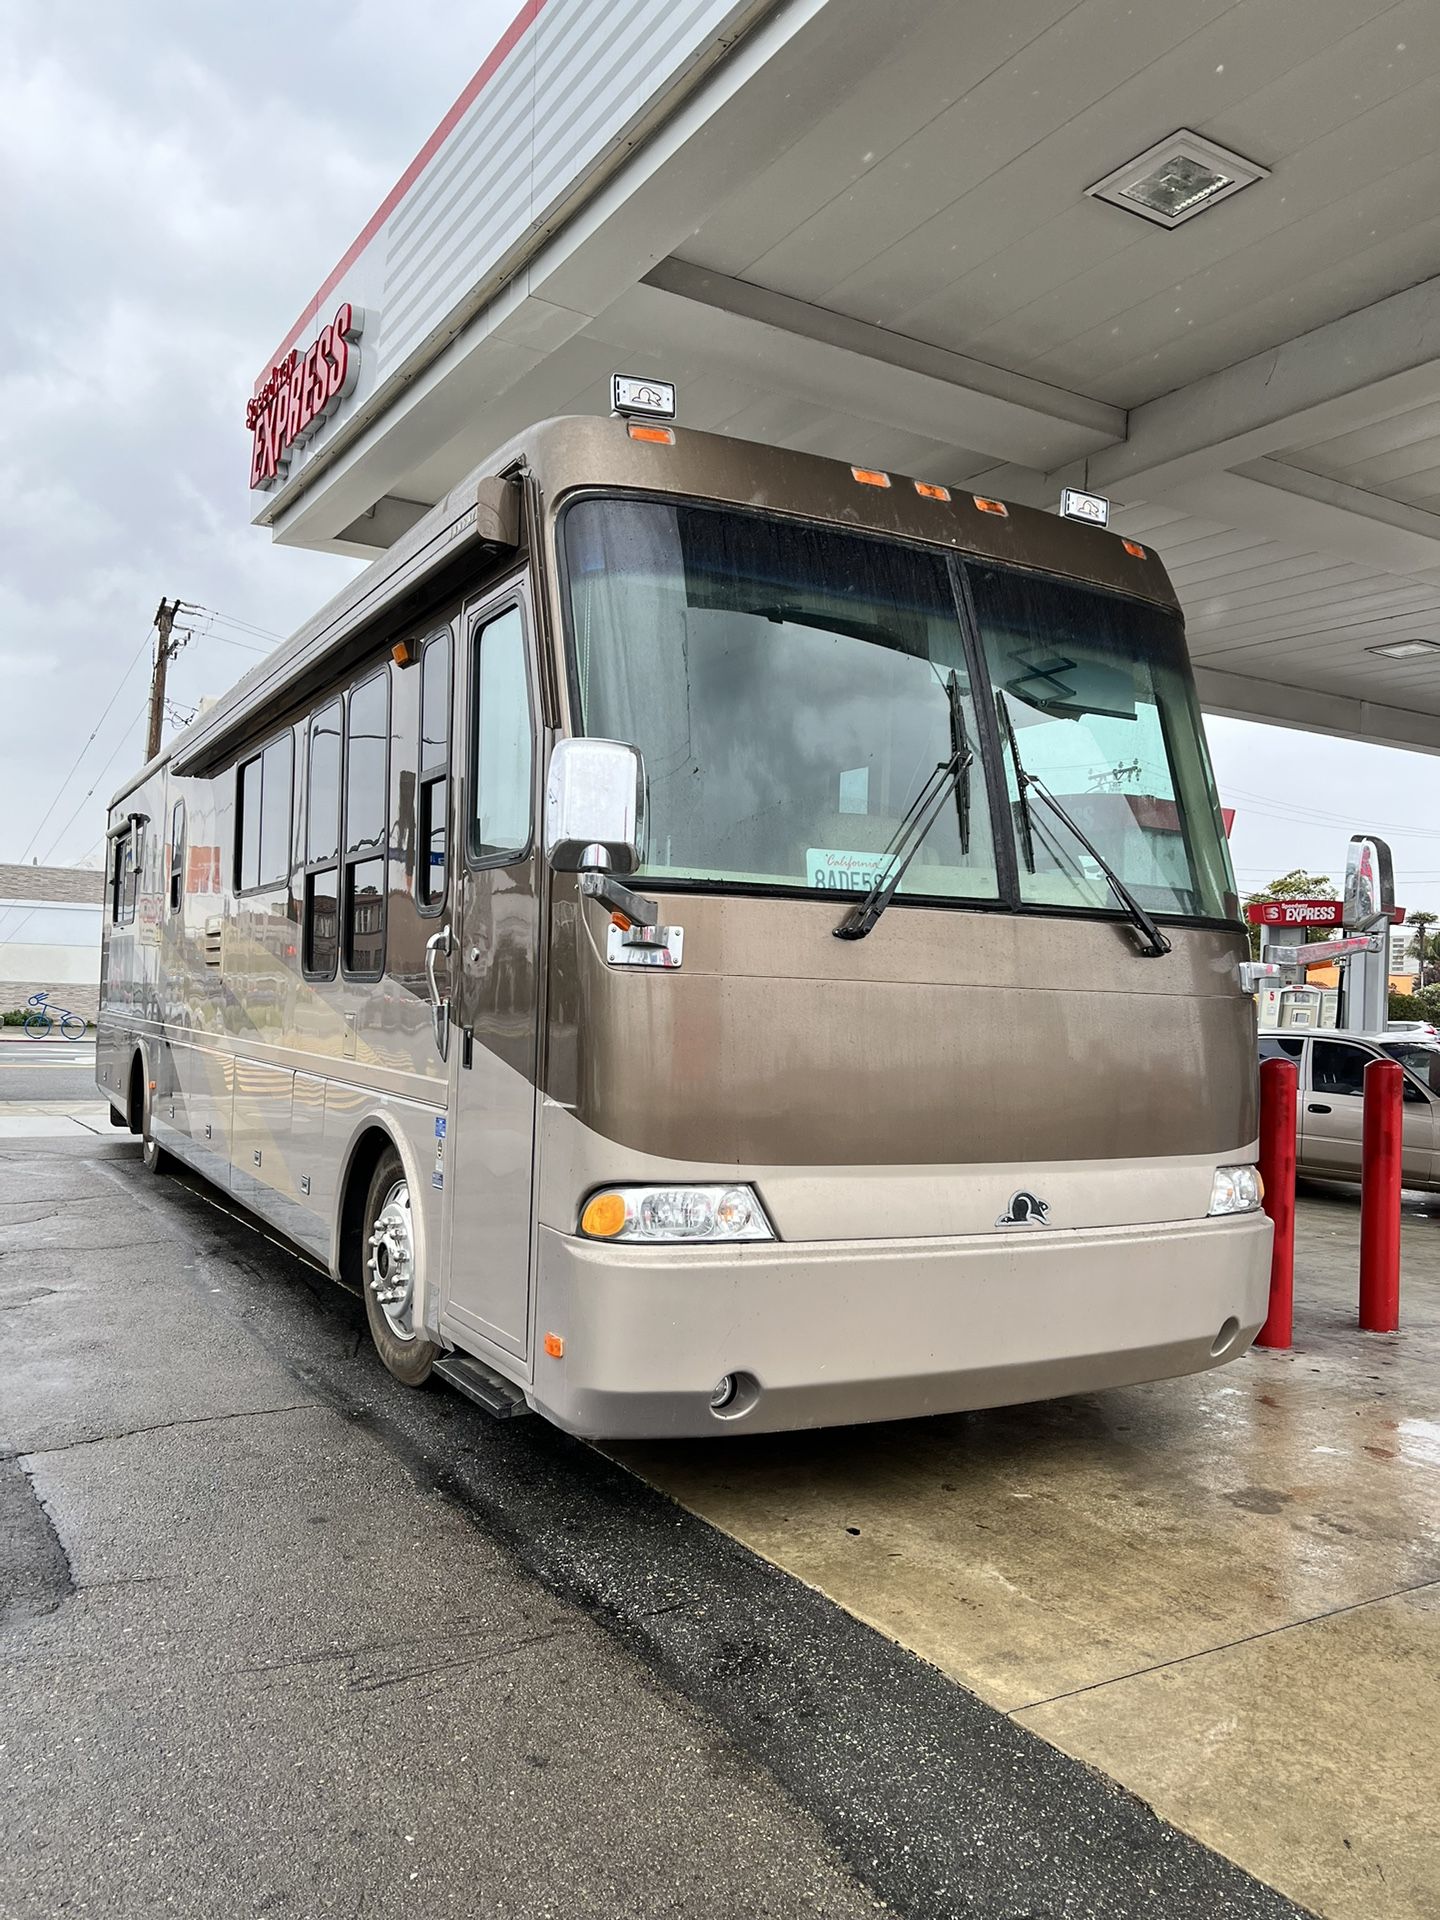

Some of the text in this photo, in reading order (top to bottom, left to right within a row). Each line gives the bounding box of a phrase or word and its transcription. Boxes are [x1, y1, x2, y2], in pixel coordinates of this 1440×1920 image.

[250, 302, 353, 489] EXPRESS
[827, 853, 884, 870] California
[815, 869, 894, 891] 8ADE5
[1285, 906, 1336, 922] EXPRESS
[1269, 991, 1275, 1001] 5
